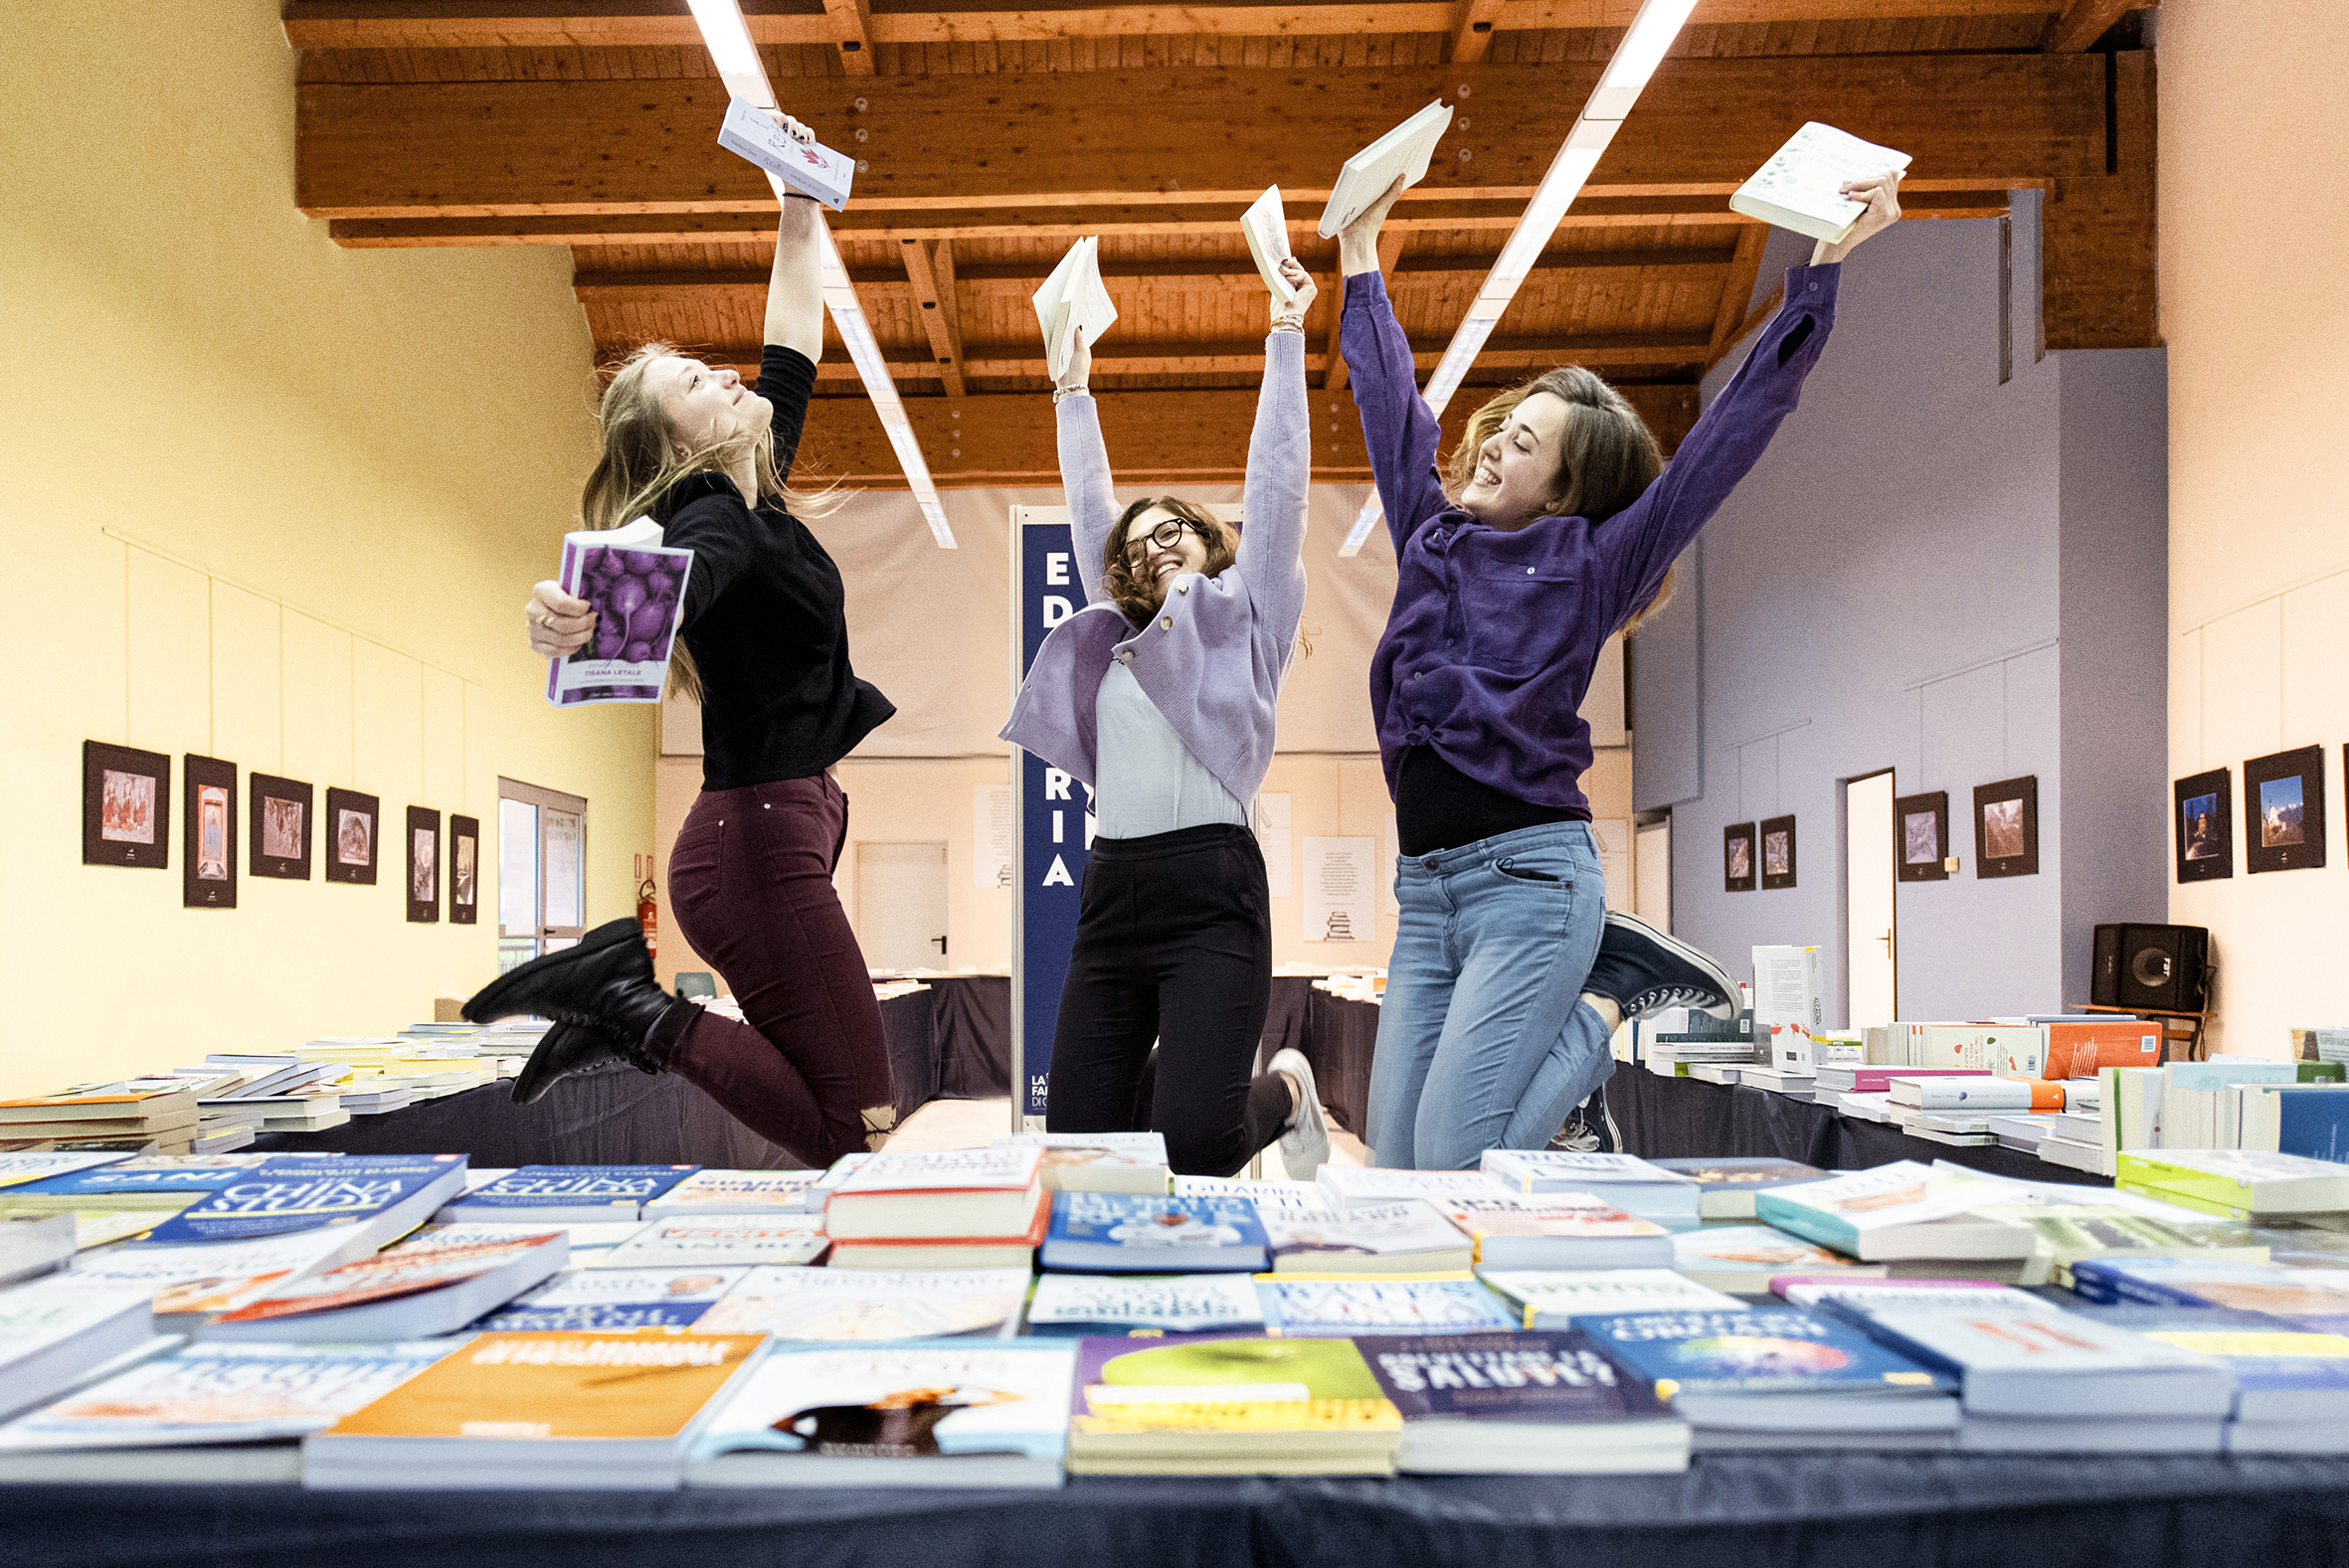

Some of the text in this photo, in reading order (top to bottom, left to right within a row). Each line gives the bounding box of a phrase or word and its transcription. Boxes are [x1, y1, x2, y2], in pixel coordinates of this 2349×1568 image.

[80, 1171, 239, 1184] SANI
[221, 1179, 403, 1199] CHINA
[199, 1192, 392, 1212] STUDY
